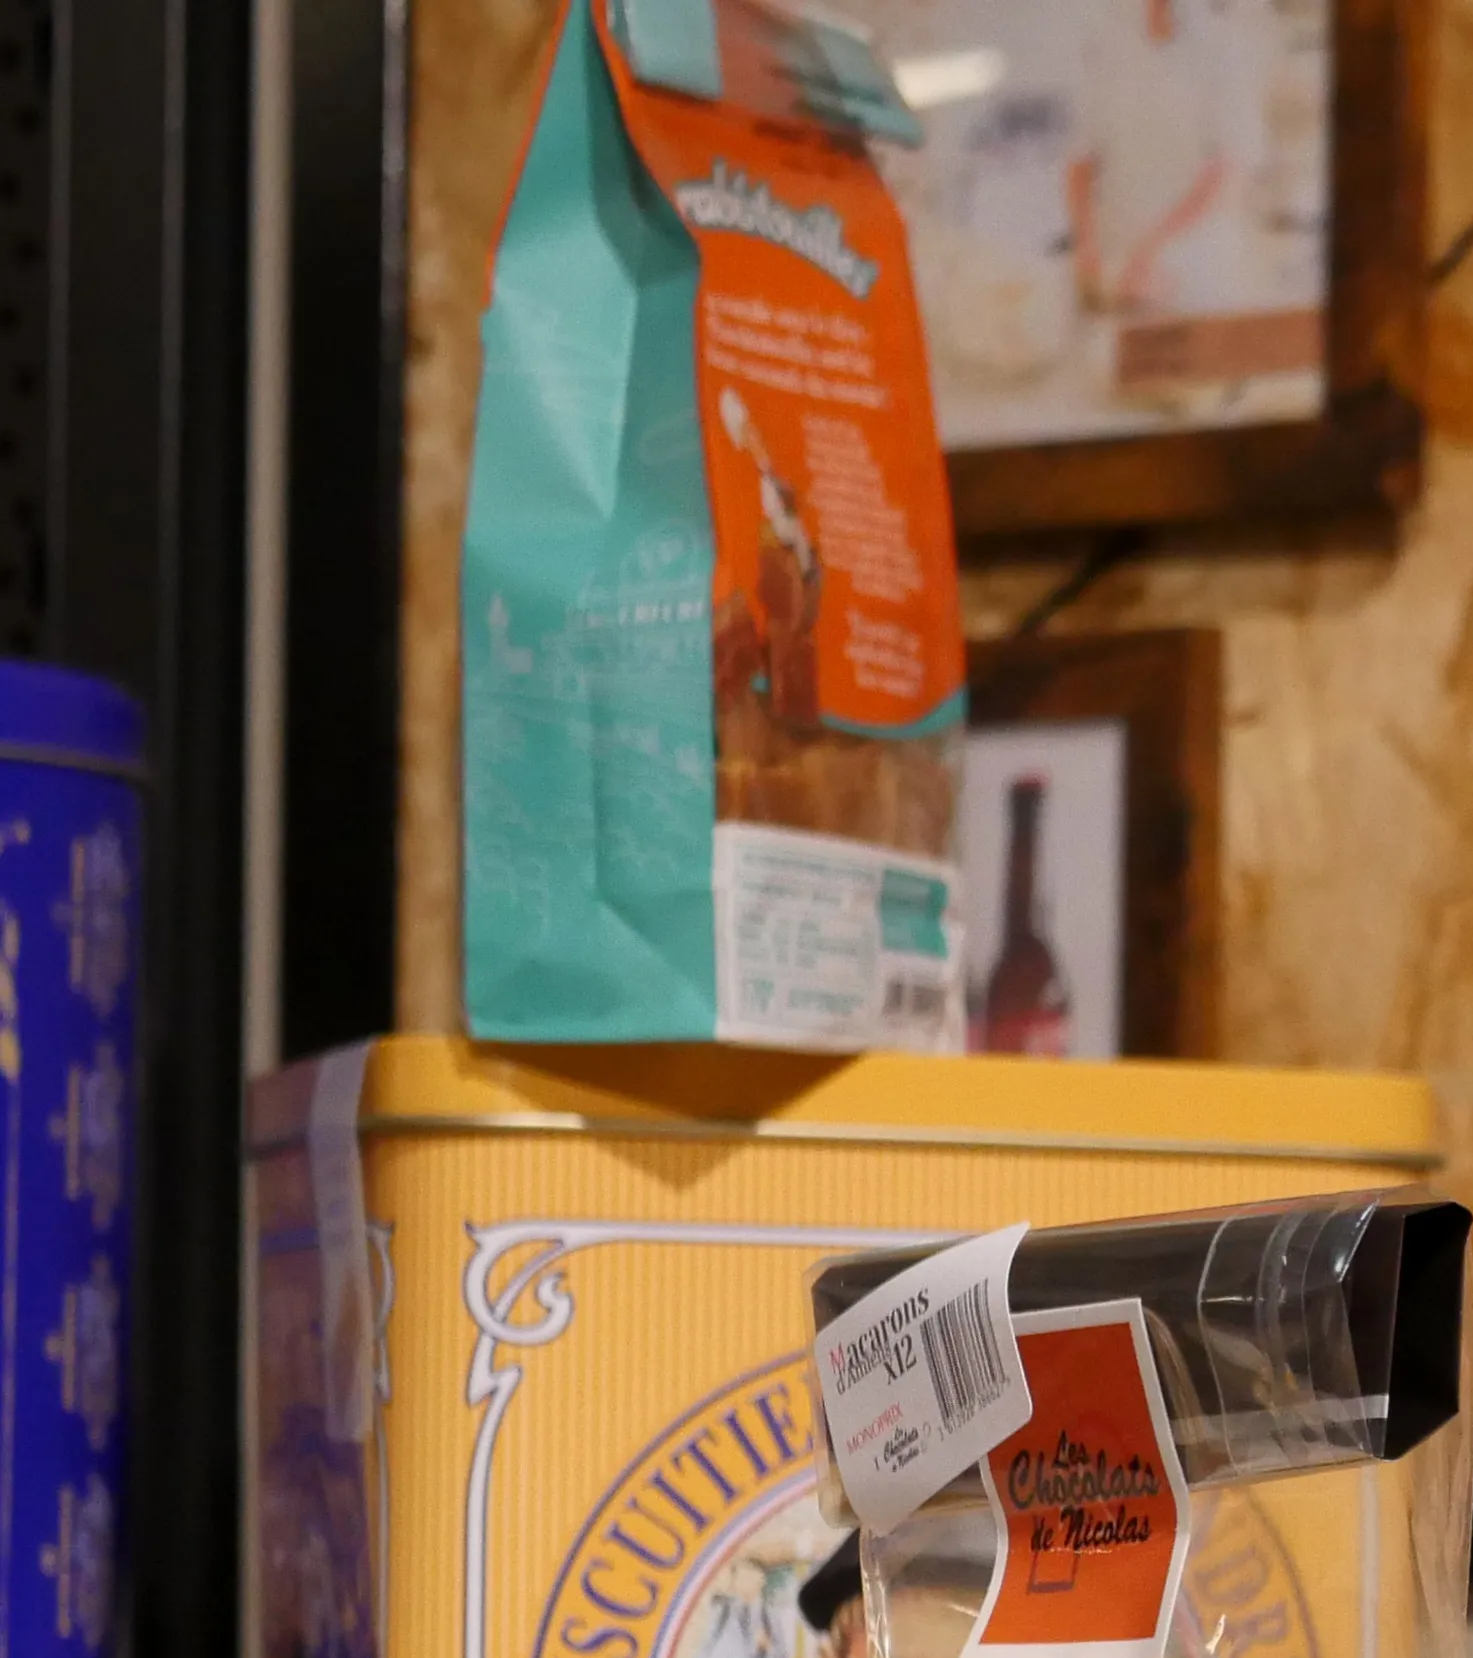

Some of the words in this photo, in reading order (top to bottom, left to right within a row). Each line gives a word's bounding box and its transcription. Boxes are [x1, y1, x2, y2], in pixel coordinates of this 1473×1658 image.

[829, 1287, 930, 1374] Macarons
[845, 1402, 903, 1455] MONOPRIX
[1055, 1430, 1090, 1469] Les
[1009, 1449, 1159, 1510] Chocolats
[1031, 1515, 1055, 1551] de
[1061, 1504, 1152, 1549] Nicolas
